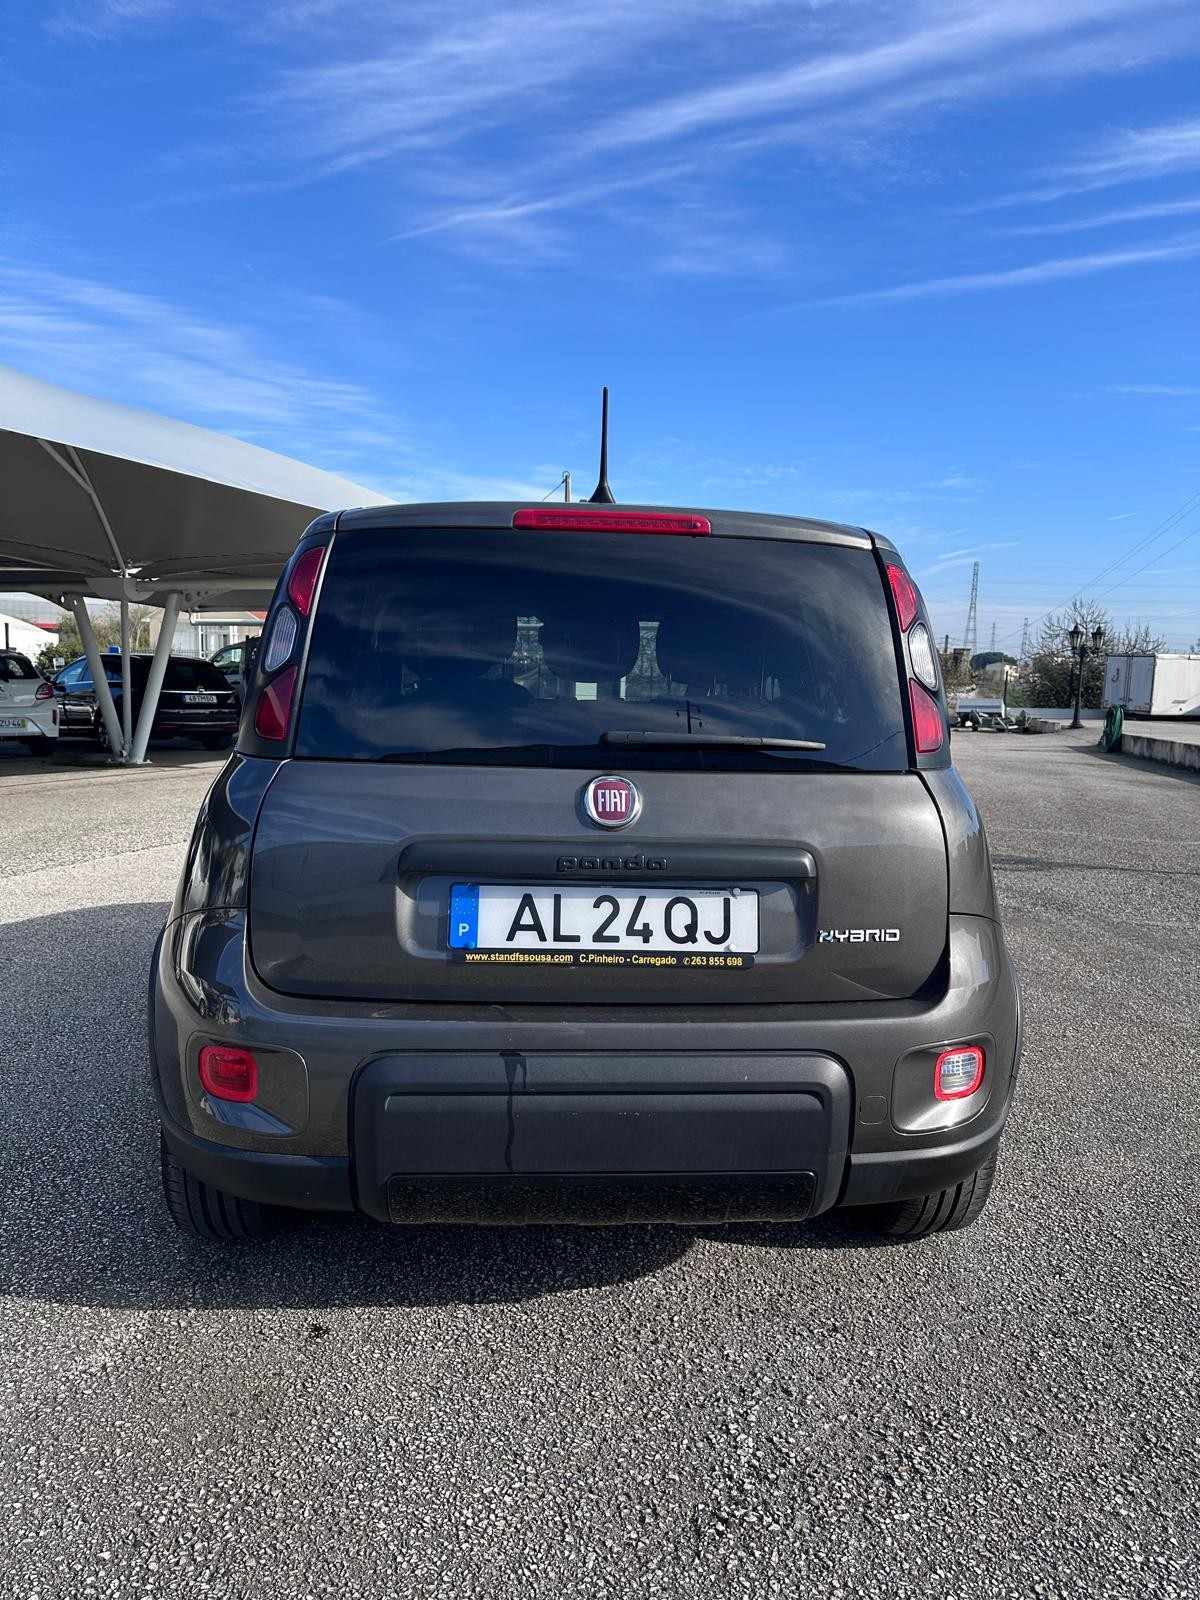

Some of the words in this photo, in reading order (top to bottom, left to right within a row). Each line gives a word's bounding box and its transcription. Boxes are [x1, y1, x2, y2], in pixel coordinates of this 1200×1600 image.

[597, 788, 628, 812] FIAT
[556, 855, 669, 873] panda
[458, 923, 470, 937] P
[819, 928, 901, 943] HYBRID
[465, 951, 574, 963] www.standfssousa.com
[631, 954, 677, 967] Carregado
[708, 956, 725, 966] 855
[726, 956, 743, 967] 698
